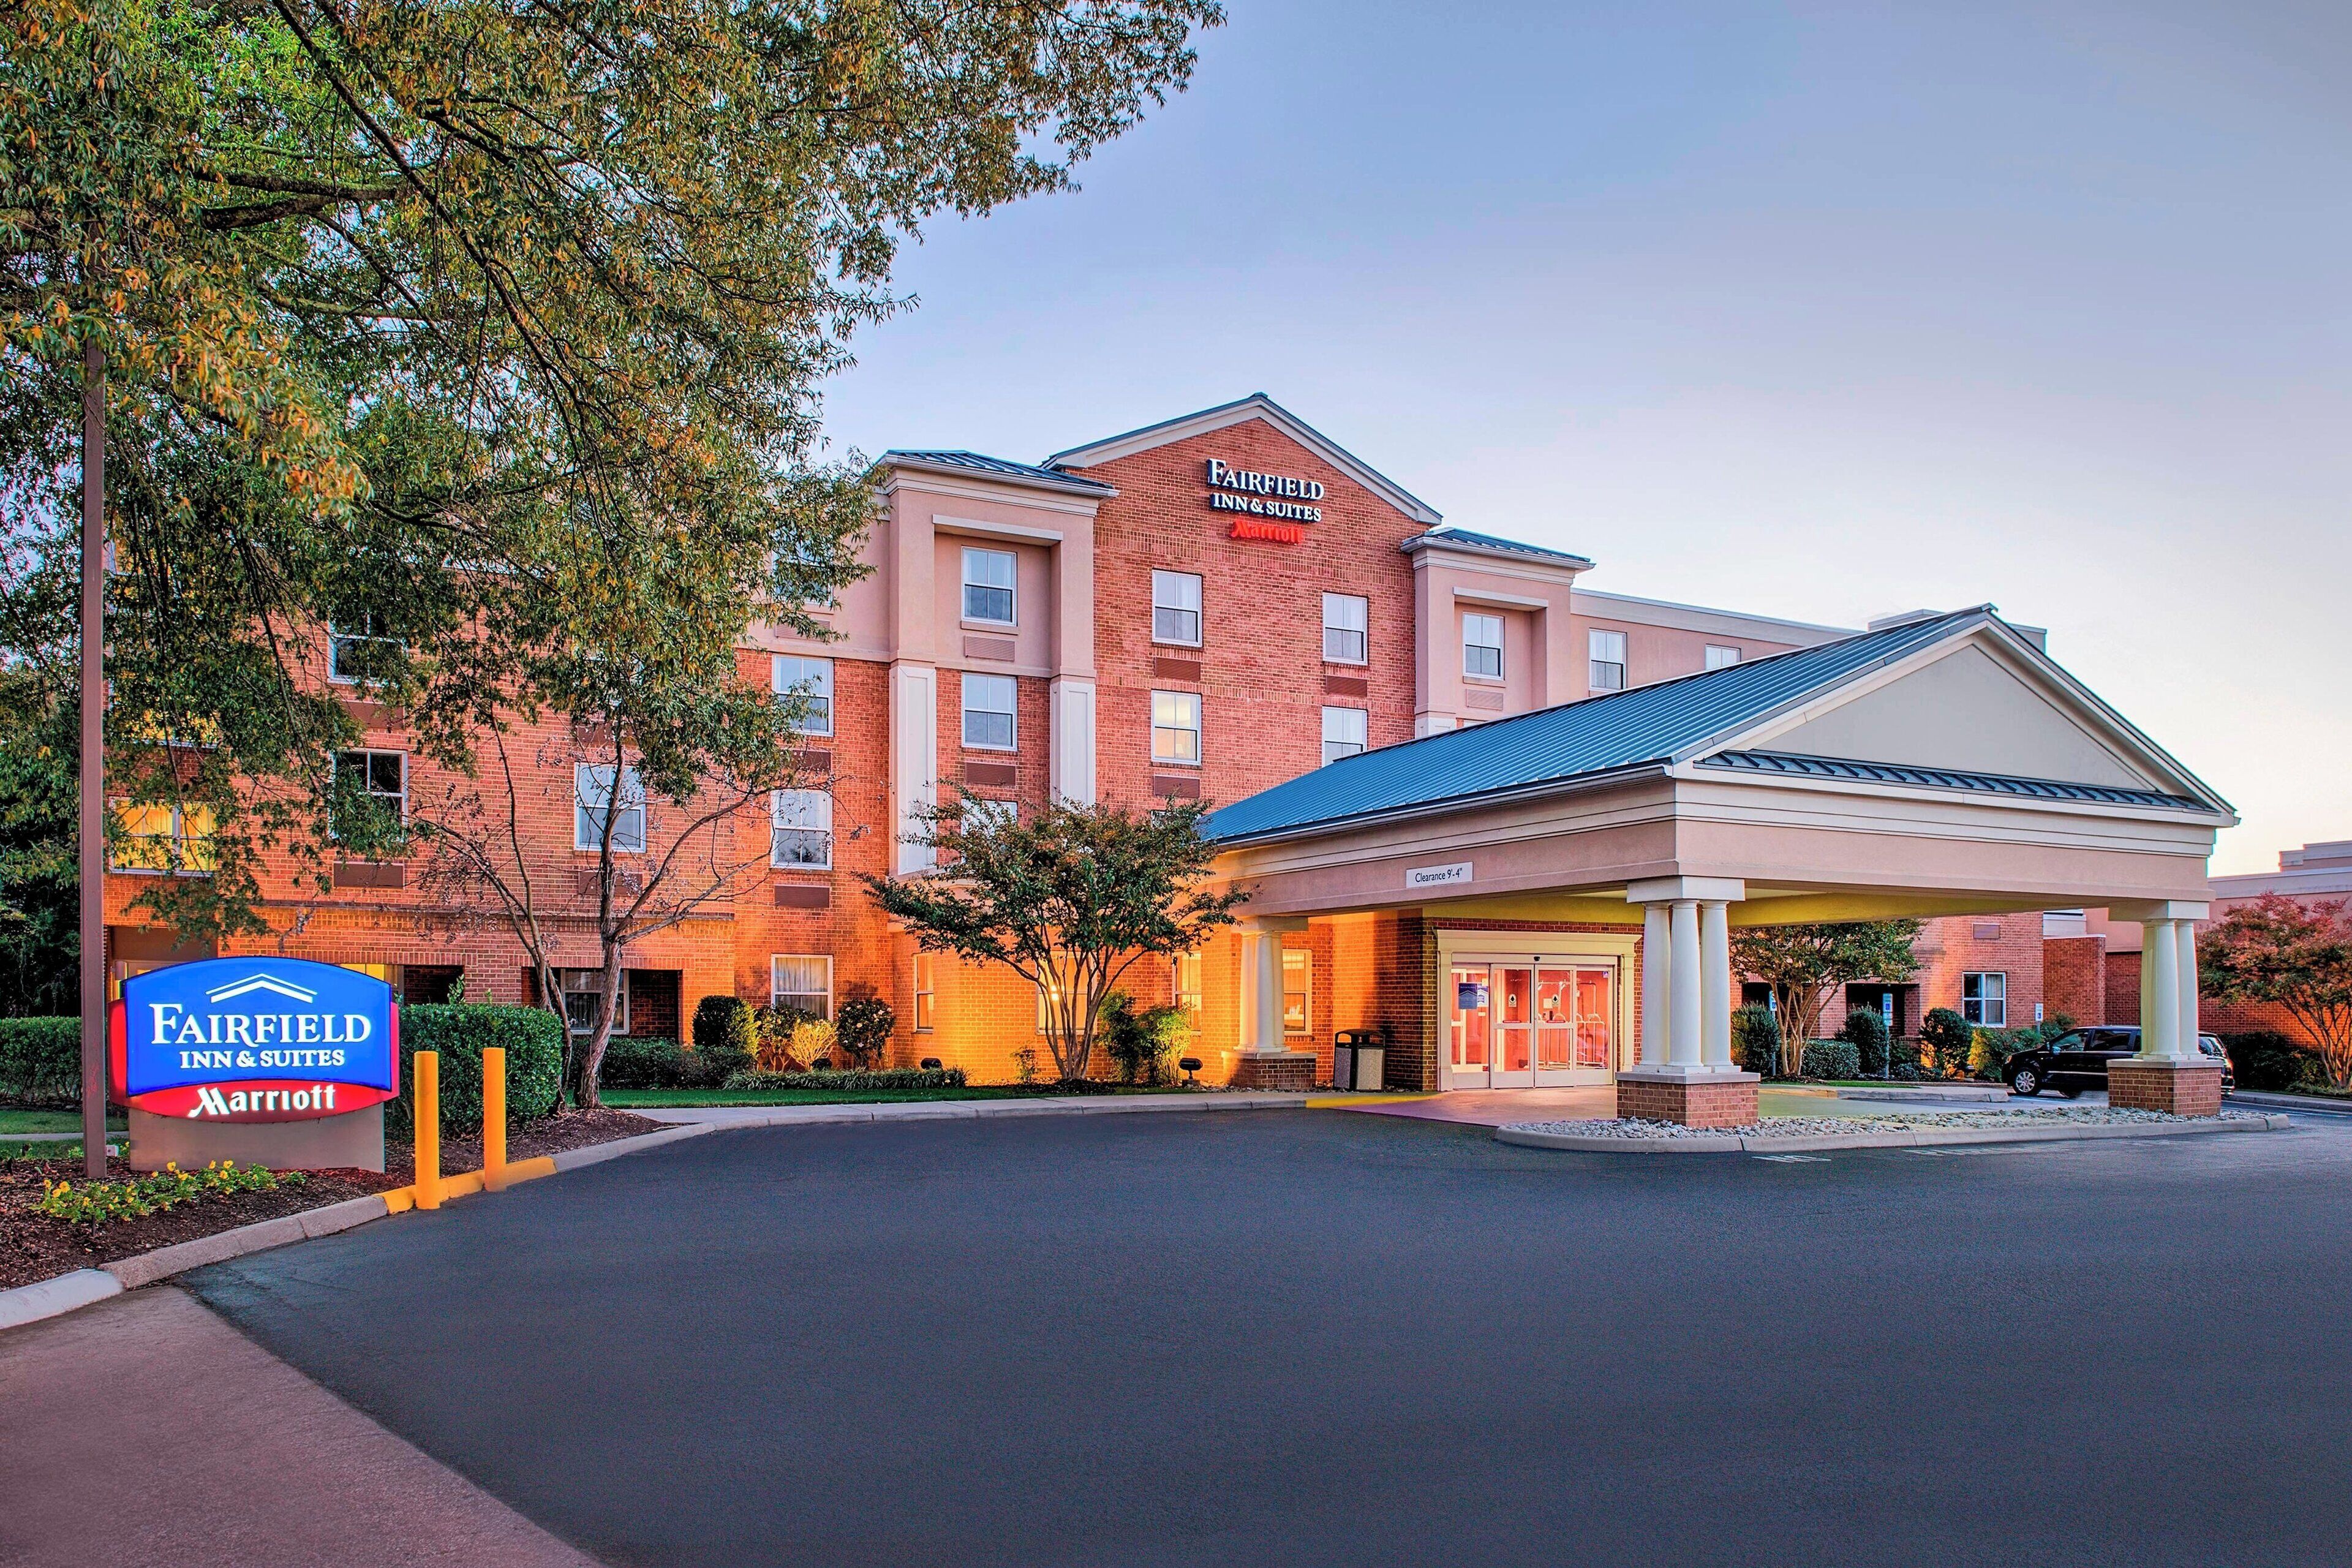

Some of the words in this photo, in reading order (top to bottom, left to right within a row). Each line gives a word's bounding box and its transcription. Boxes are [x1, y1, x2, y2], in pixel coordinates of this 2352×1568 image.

[1207, 458, 1325, 500] FAIRFIELD
[1212, 492, 1248, 511] INN
[1250, 498, 1264, 514] &
[1266, 500, 1322, 522] SUITES
[1231, 517, 1303, 543] Marriott
[1415, 872, 1446, 883] Clearance
[149, 1003, 371, 1047] FAIRFIELD
[179, 1050, 232, 1069] INN
[236, 1050, 258, 1068] &
[260, 1049, 345, 1068] SUITES
[187, 1084, 336, 1118] Marriott
